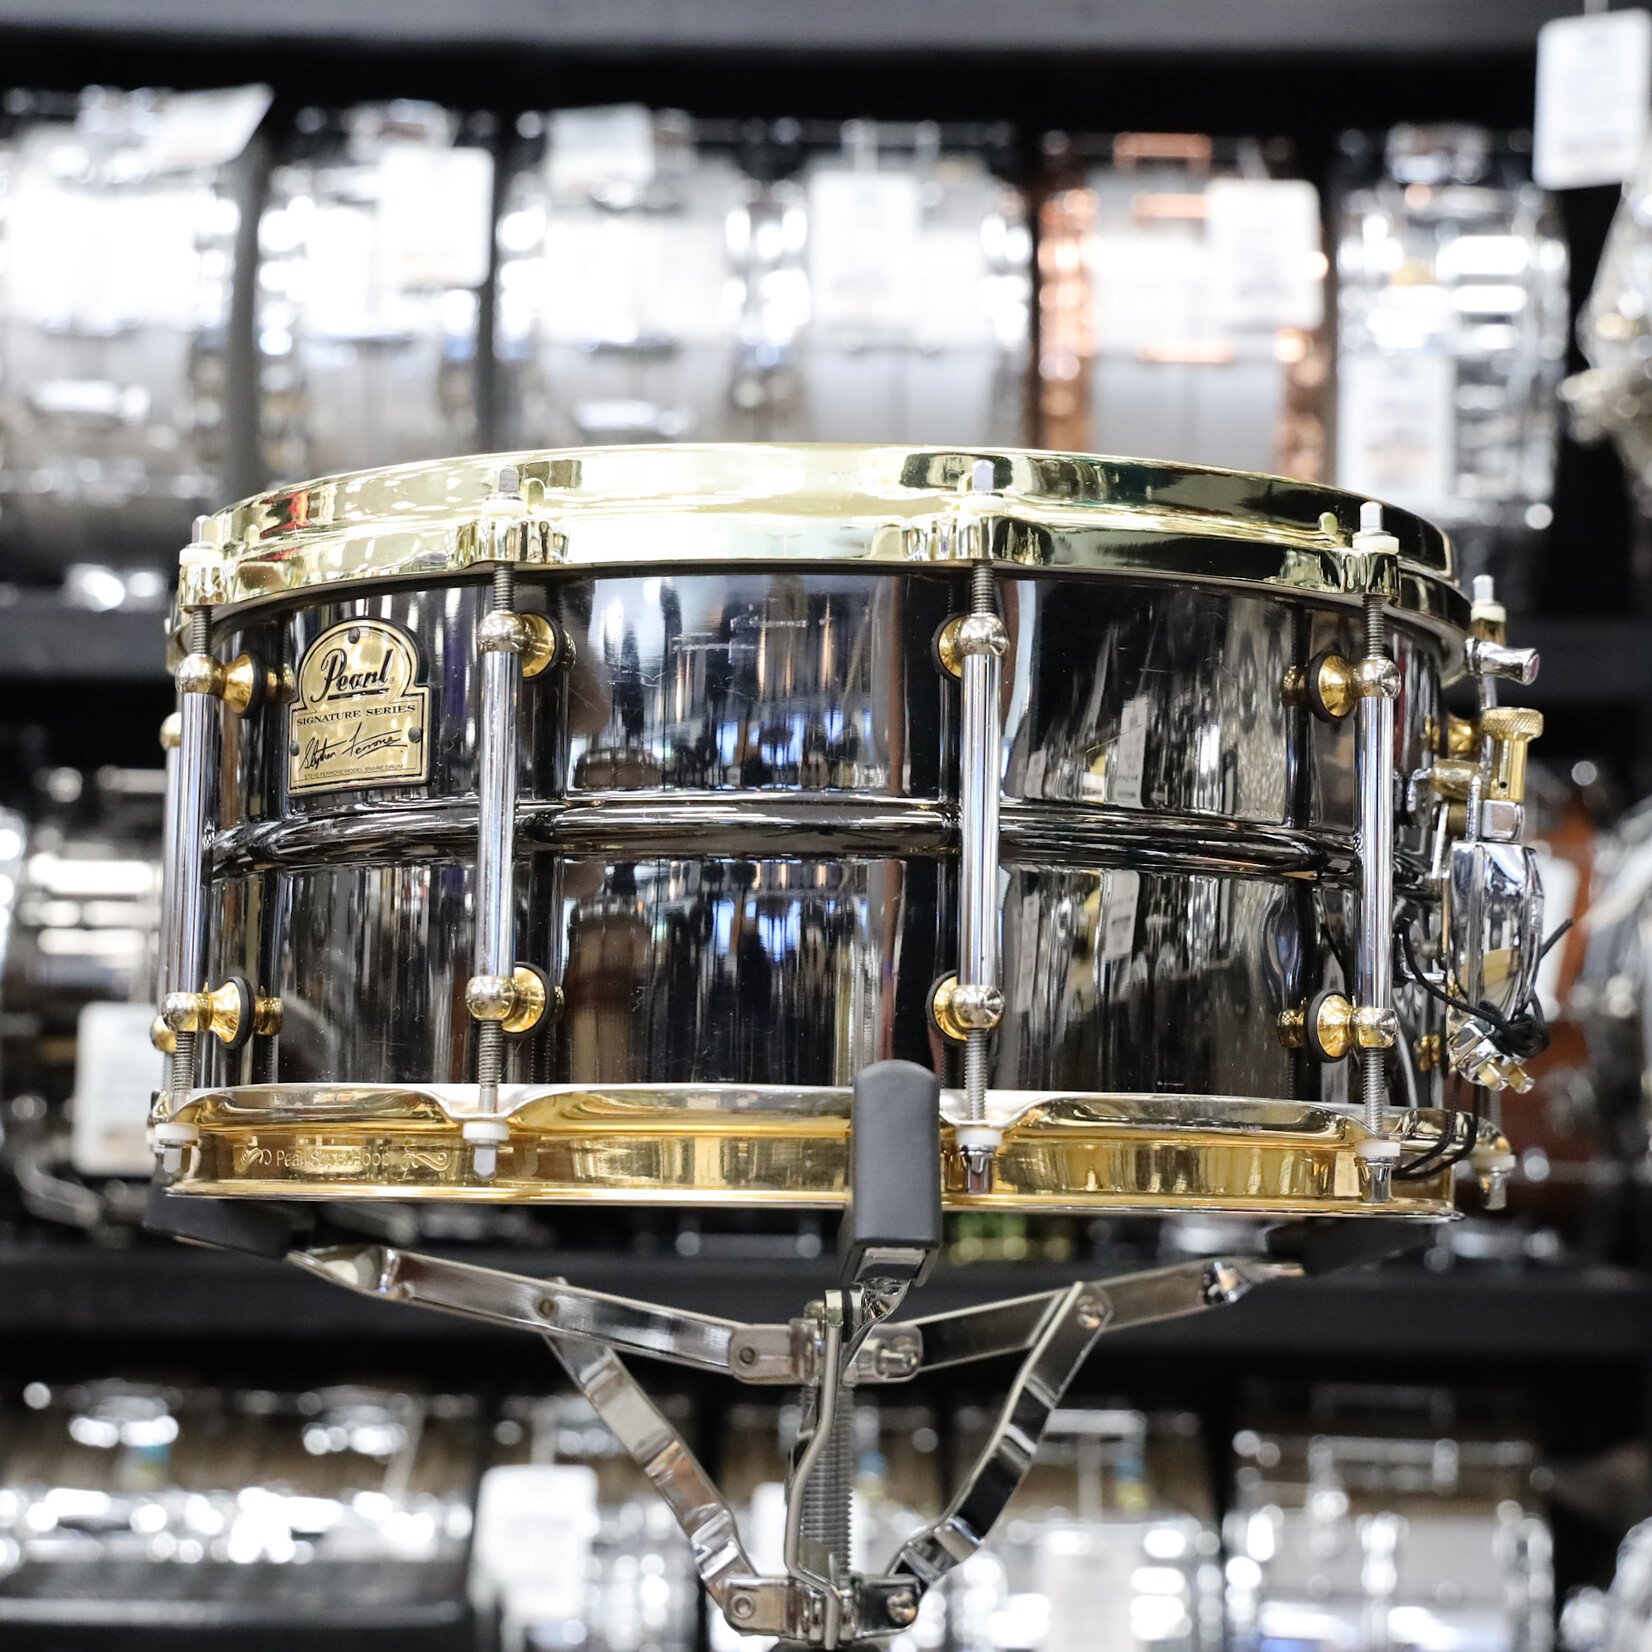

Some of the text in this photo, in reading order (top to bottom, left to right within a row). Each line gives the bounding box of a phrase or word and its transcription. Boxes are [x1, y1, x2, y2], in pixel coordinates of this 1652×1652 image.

[310, 648, 394, 702] Pearl
[296, 704, 416, 727] SIGNATURE SERIES
[344, 767, 363, 775] MODEL
[365, 765, 383, 773] SNARE
